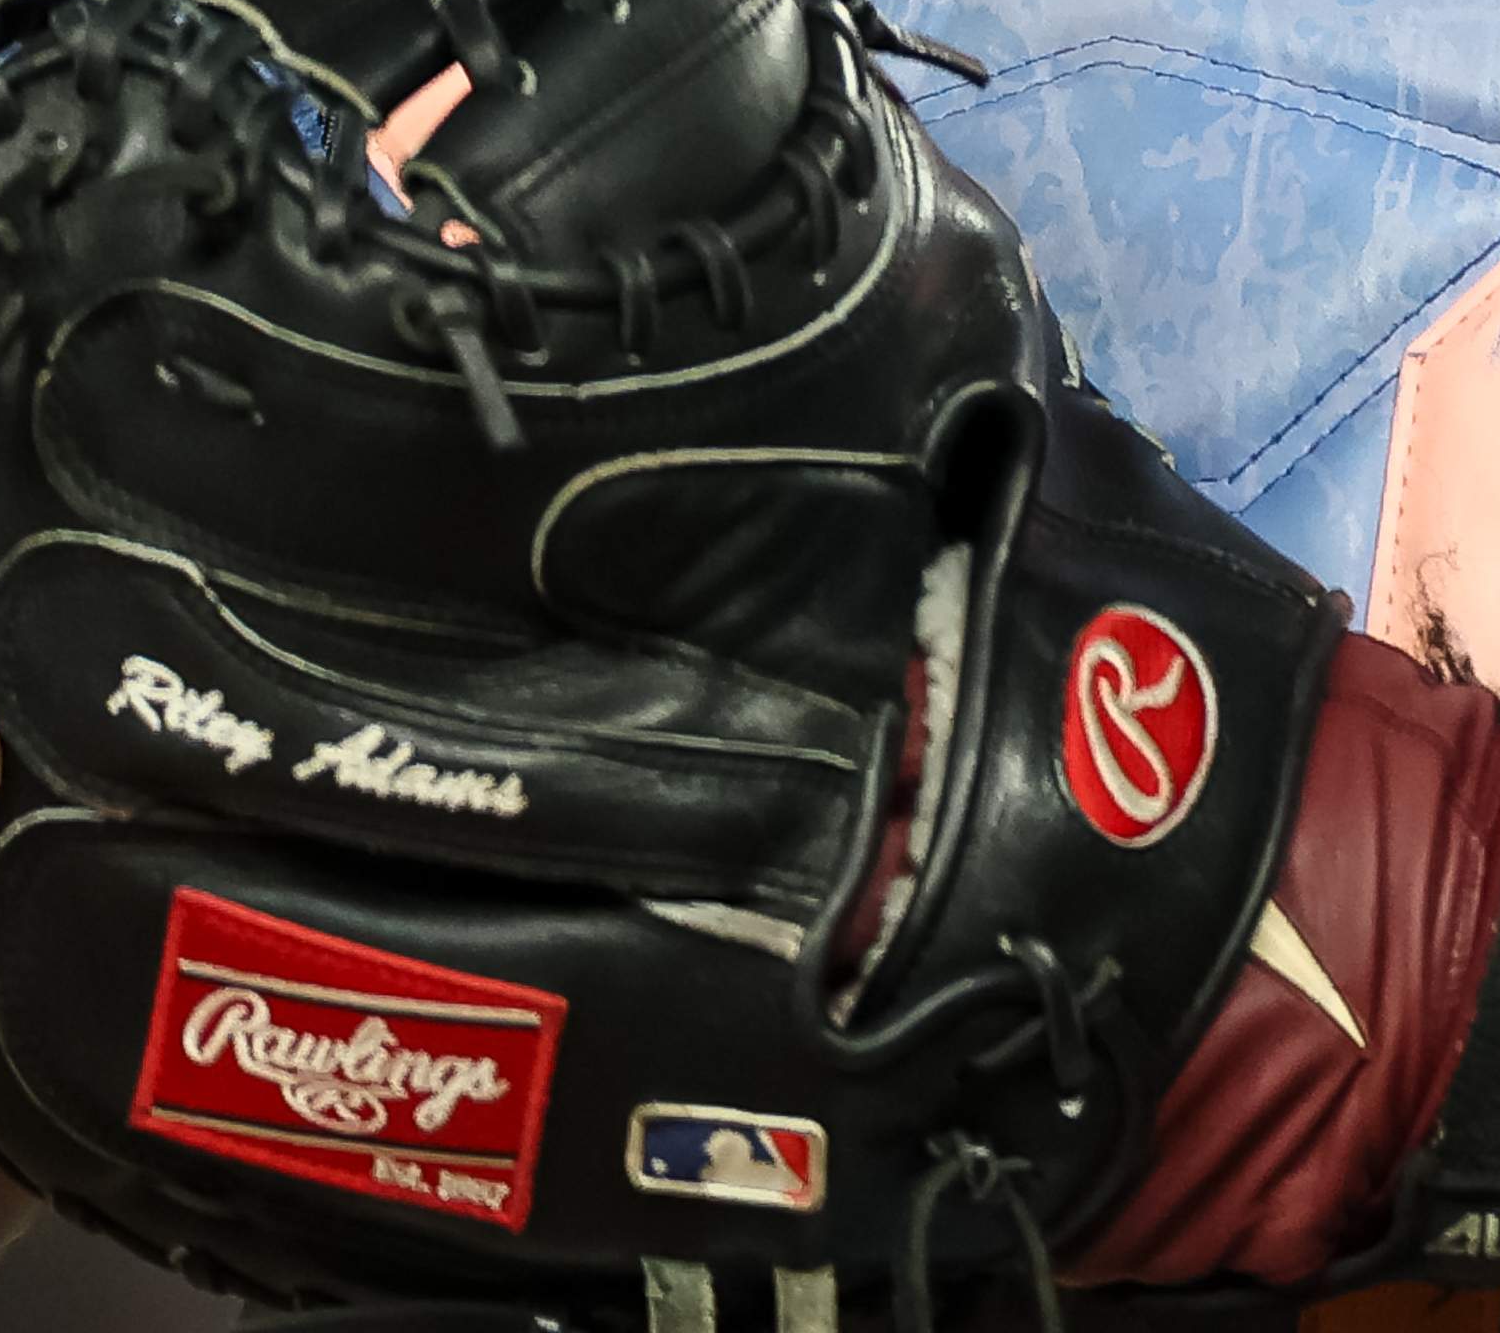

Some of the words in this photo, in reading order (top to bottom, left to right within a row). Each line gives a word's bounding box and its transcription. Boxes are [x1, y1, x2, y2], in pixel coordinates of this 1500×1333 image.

[106, 654, 275, 776] Riley
[292, 722, 530, 818] Adams
[1077, 636, 1185, 824] R
[182, 987, 512, 1133] Rawlings
